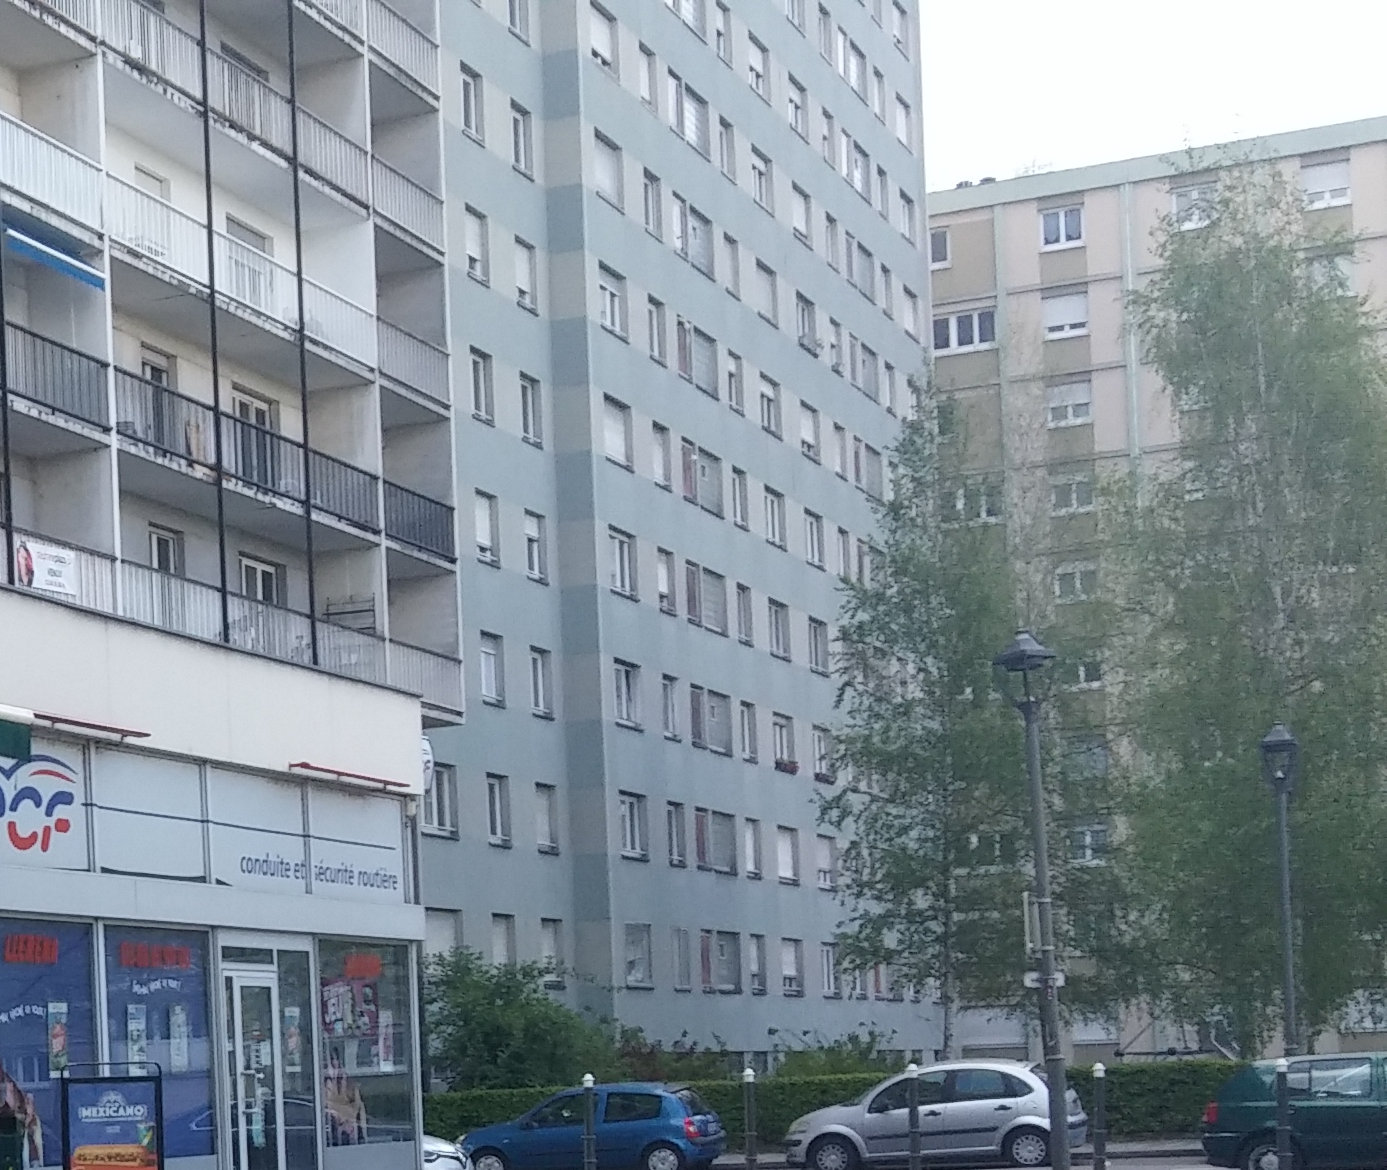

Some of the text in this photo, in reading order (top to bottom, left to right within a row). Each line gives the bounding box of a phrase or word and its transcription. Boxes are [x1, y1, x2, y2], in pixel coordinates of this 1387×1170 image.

[240, 851, 398, 891] conduite et sécurité routière
[80, 1104, 146, 1118] MEXICANO
